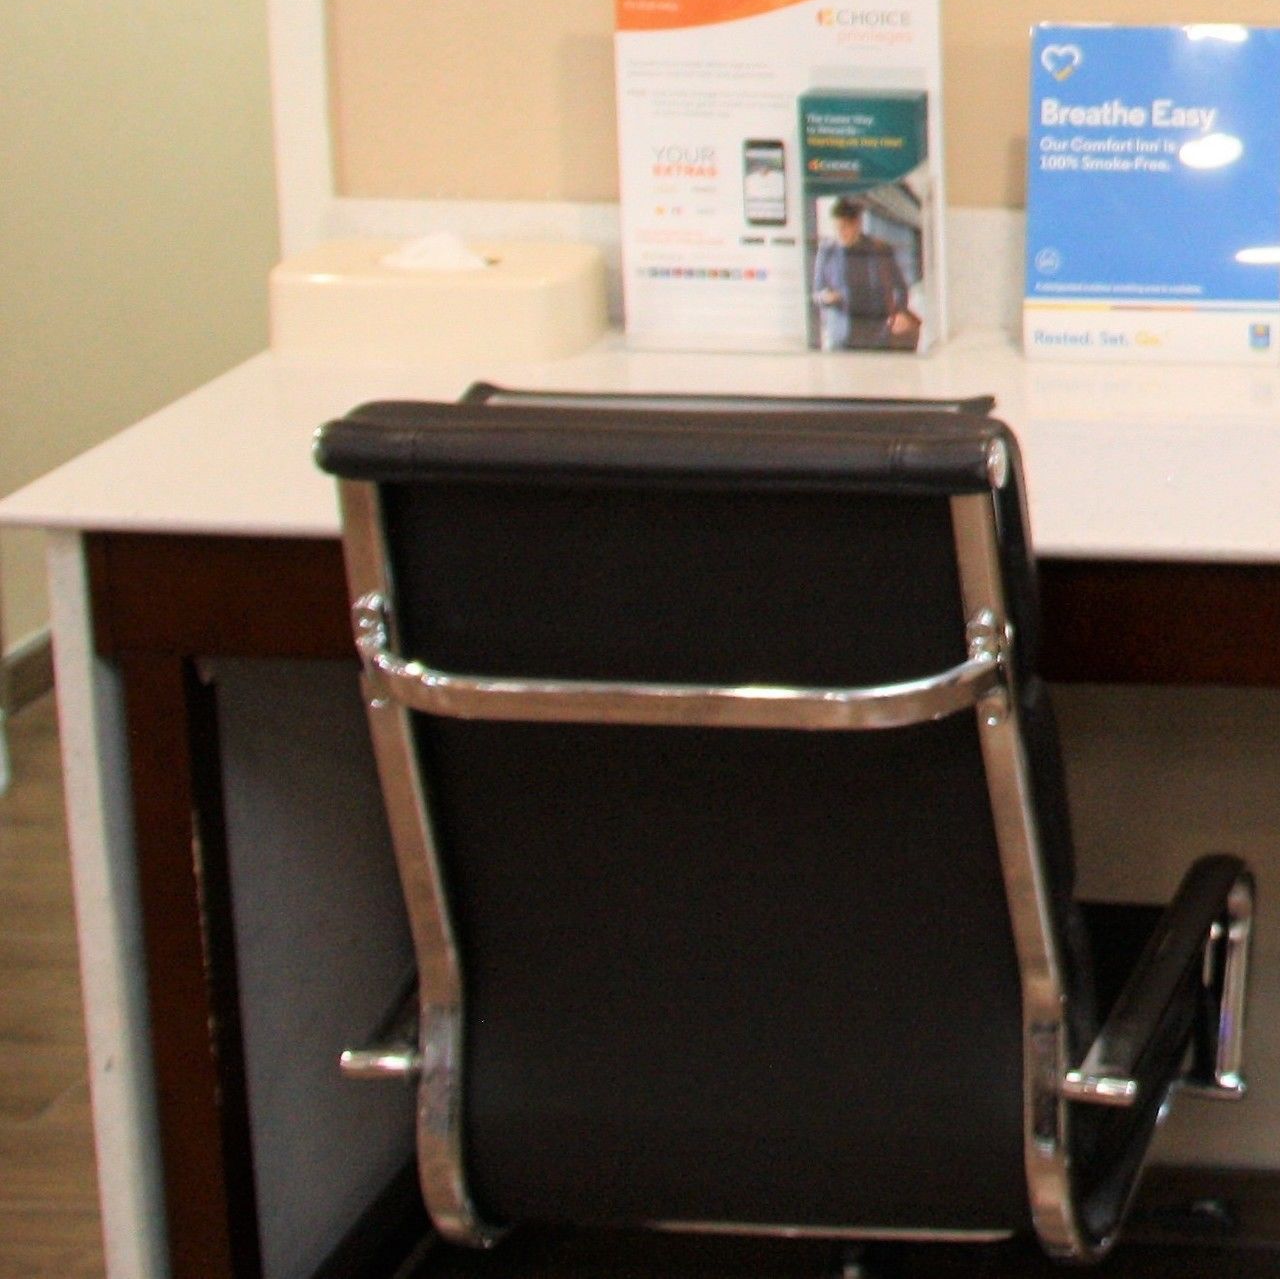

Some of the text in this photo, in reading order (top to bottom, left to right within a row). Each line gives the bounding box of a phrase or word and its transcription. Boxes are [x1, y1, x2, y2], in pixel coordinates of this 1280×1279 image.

[836, 9, 911, 26] CHOICE
[1040, 97, 1217, 133] Breathe Easy
[651, 144, 716, 163] YOUR
[1040, 136, 1068, 152] Our
[1070, 136, 1133, 153] Comfort
[1164, 139, 1177, 154] is
[1039, 154, 1078, 170] 100%
[1034, 329, 1095, 347] Rested.
[1100, 330, 1130, 347] Set.
